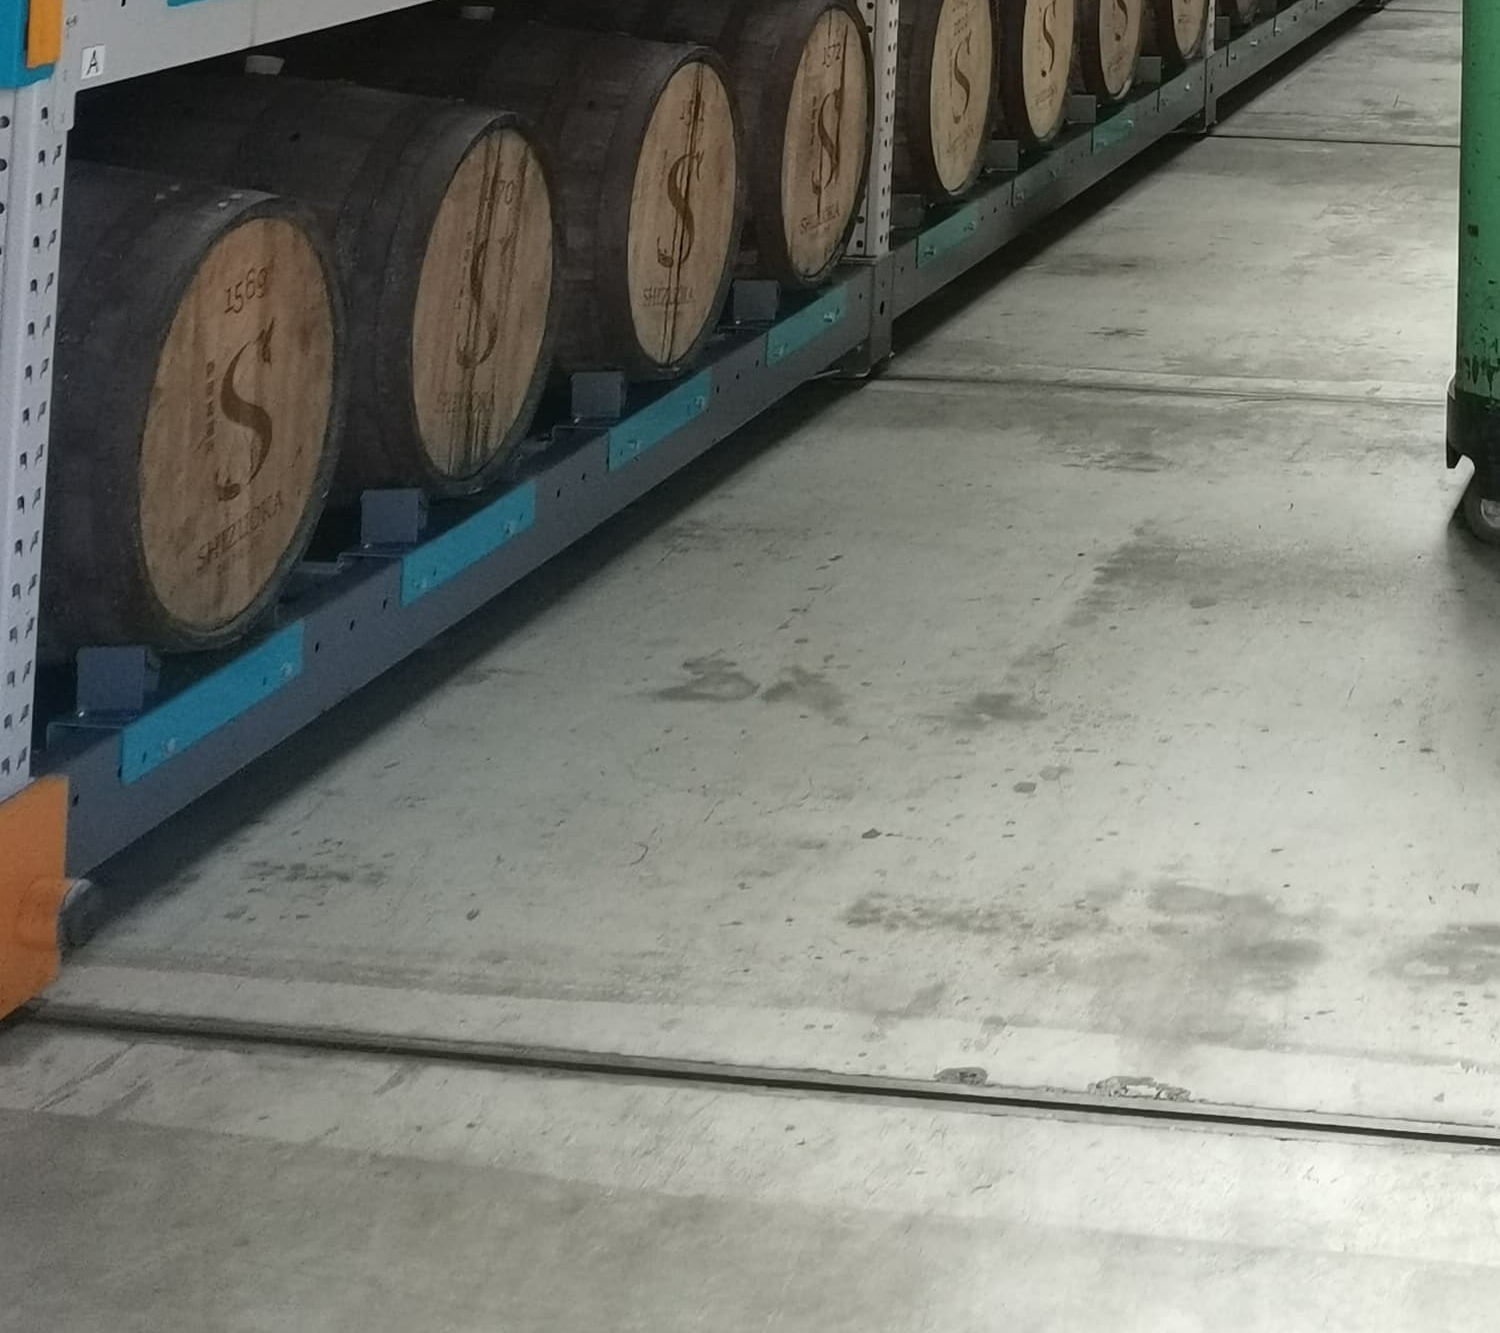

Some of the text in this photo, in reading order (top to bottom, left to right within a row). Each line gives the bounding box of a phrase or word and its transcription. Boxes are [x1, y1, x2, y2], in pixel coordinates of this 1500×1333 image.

[87, 49, 101, 76] A
[952, 27, 973, 126] S
[811, 87, 843, 198] S
[656, 149, 706, 270] S
[223, 265, 269, 315] 1569
[456, 231, 515, 371] S
[215, 316, 276, 503] S
